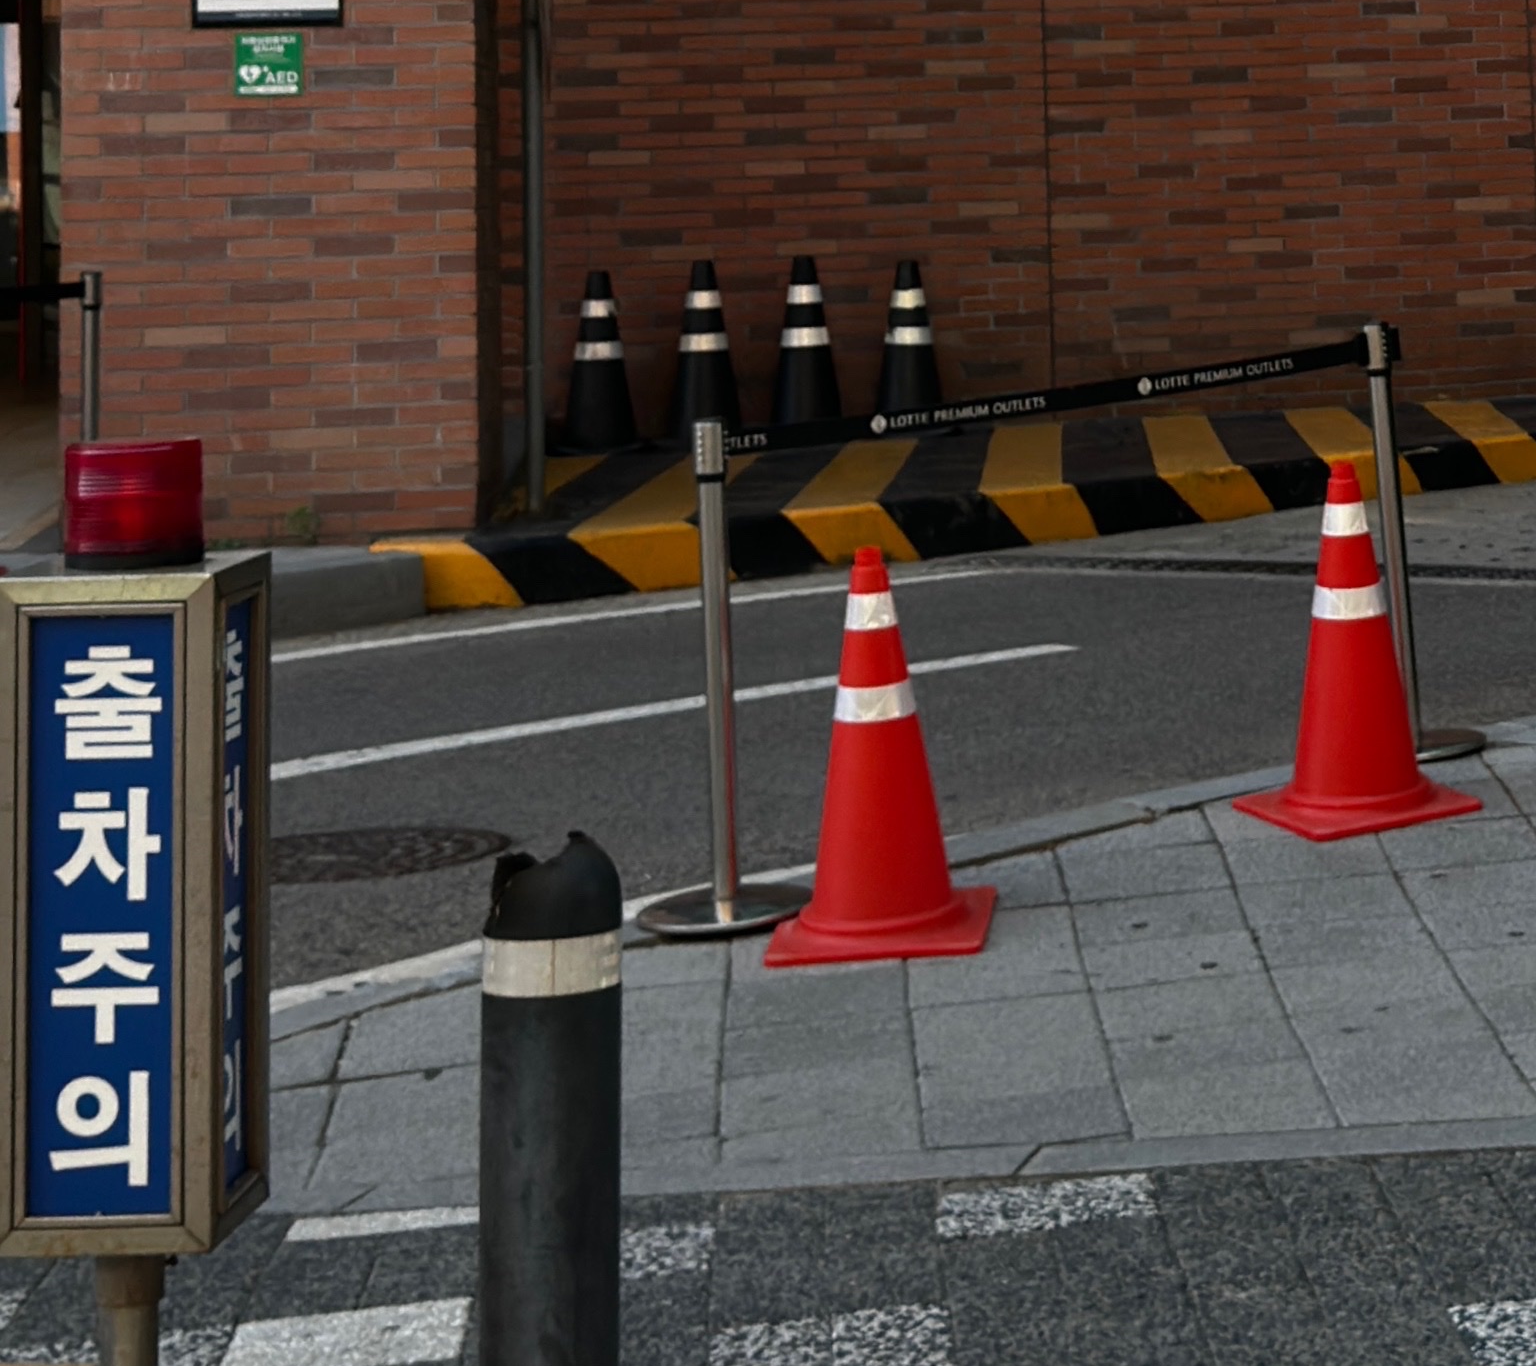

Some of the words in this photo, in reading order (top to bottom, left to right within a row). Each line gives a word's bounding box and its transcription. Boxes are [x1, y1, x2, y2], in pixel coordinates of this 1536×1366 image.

[265, 71, 299, 84] AED
[1154, 374, 1191, 390] LOTTE
[1193, 366, 1243, 385] PREMIUM
[1246, 357, 1294, 376] OUTLETS
[889, 411, 929, 428] LOTTE
[933, 403, 989, 423] PREMIUM
[992, 396, 1047, 415] OUTLETS
[730, 434, 768, 448] TLETS
[49, 645, 163, 1187] 출차주의
